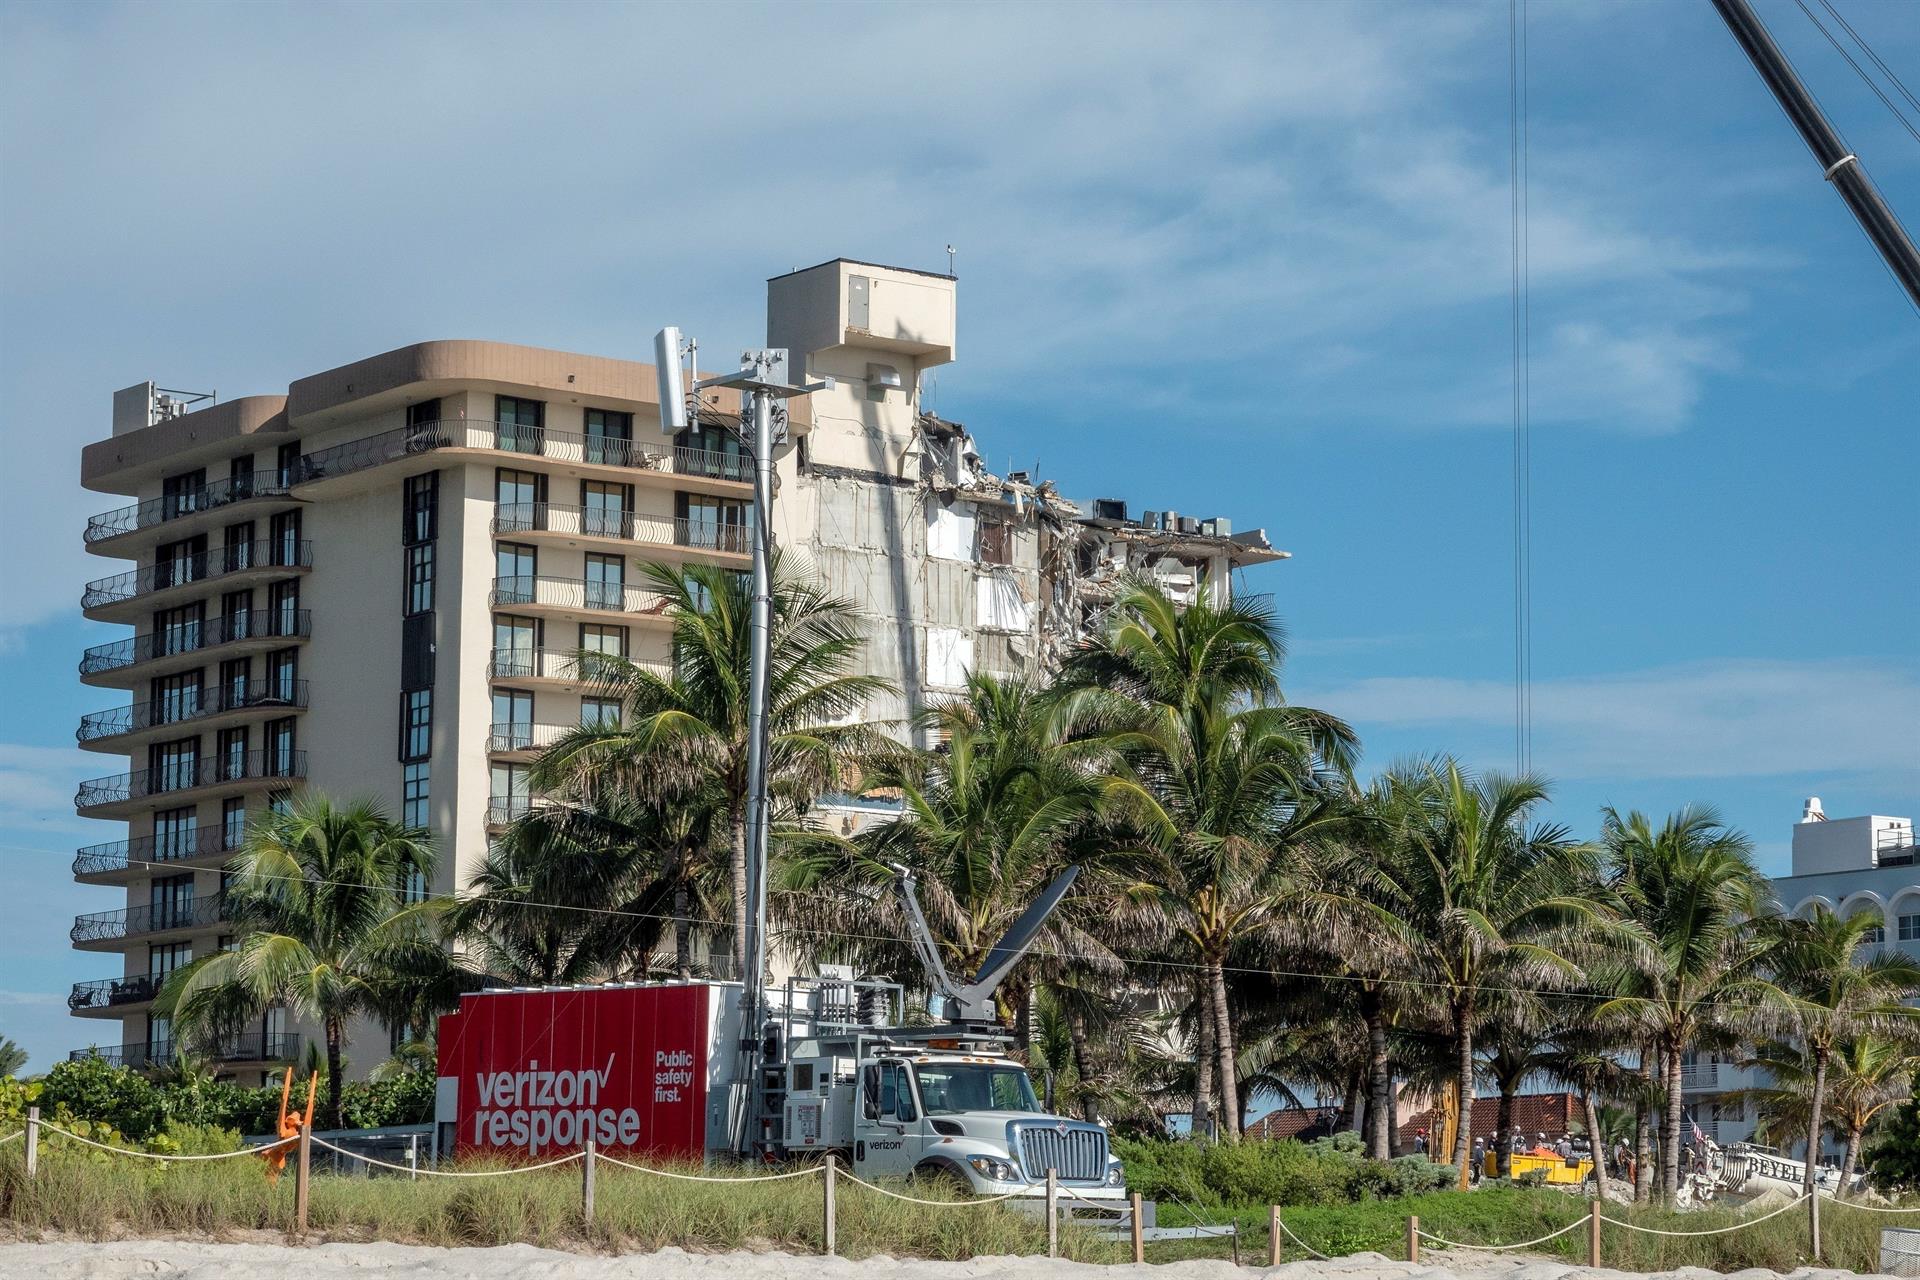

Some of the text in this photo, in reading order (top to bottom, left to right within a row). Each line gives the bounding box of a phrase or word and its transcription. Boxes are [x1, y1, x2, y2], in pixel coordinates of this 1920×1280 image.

[656, 1050, 692, 1067] Public
[477, 1060, 598, 1107] verizon
[655, 1069, 692, 1087] safety
[654, 1087, 681, 1102] first.
[475, 1108, 640, 1156] response
[869, 1140, 901, 1150] verizon
[1749, 1157, 1801, 1182] BEYEL
